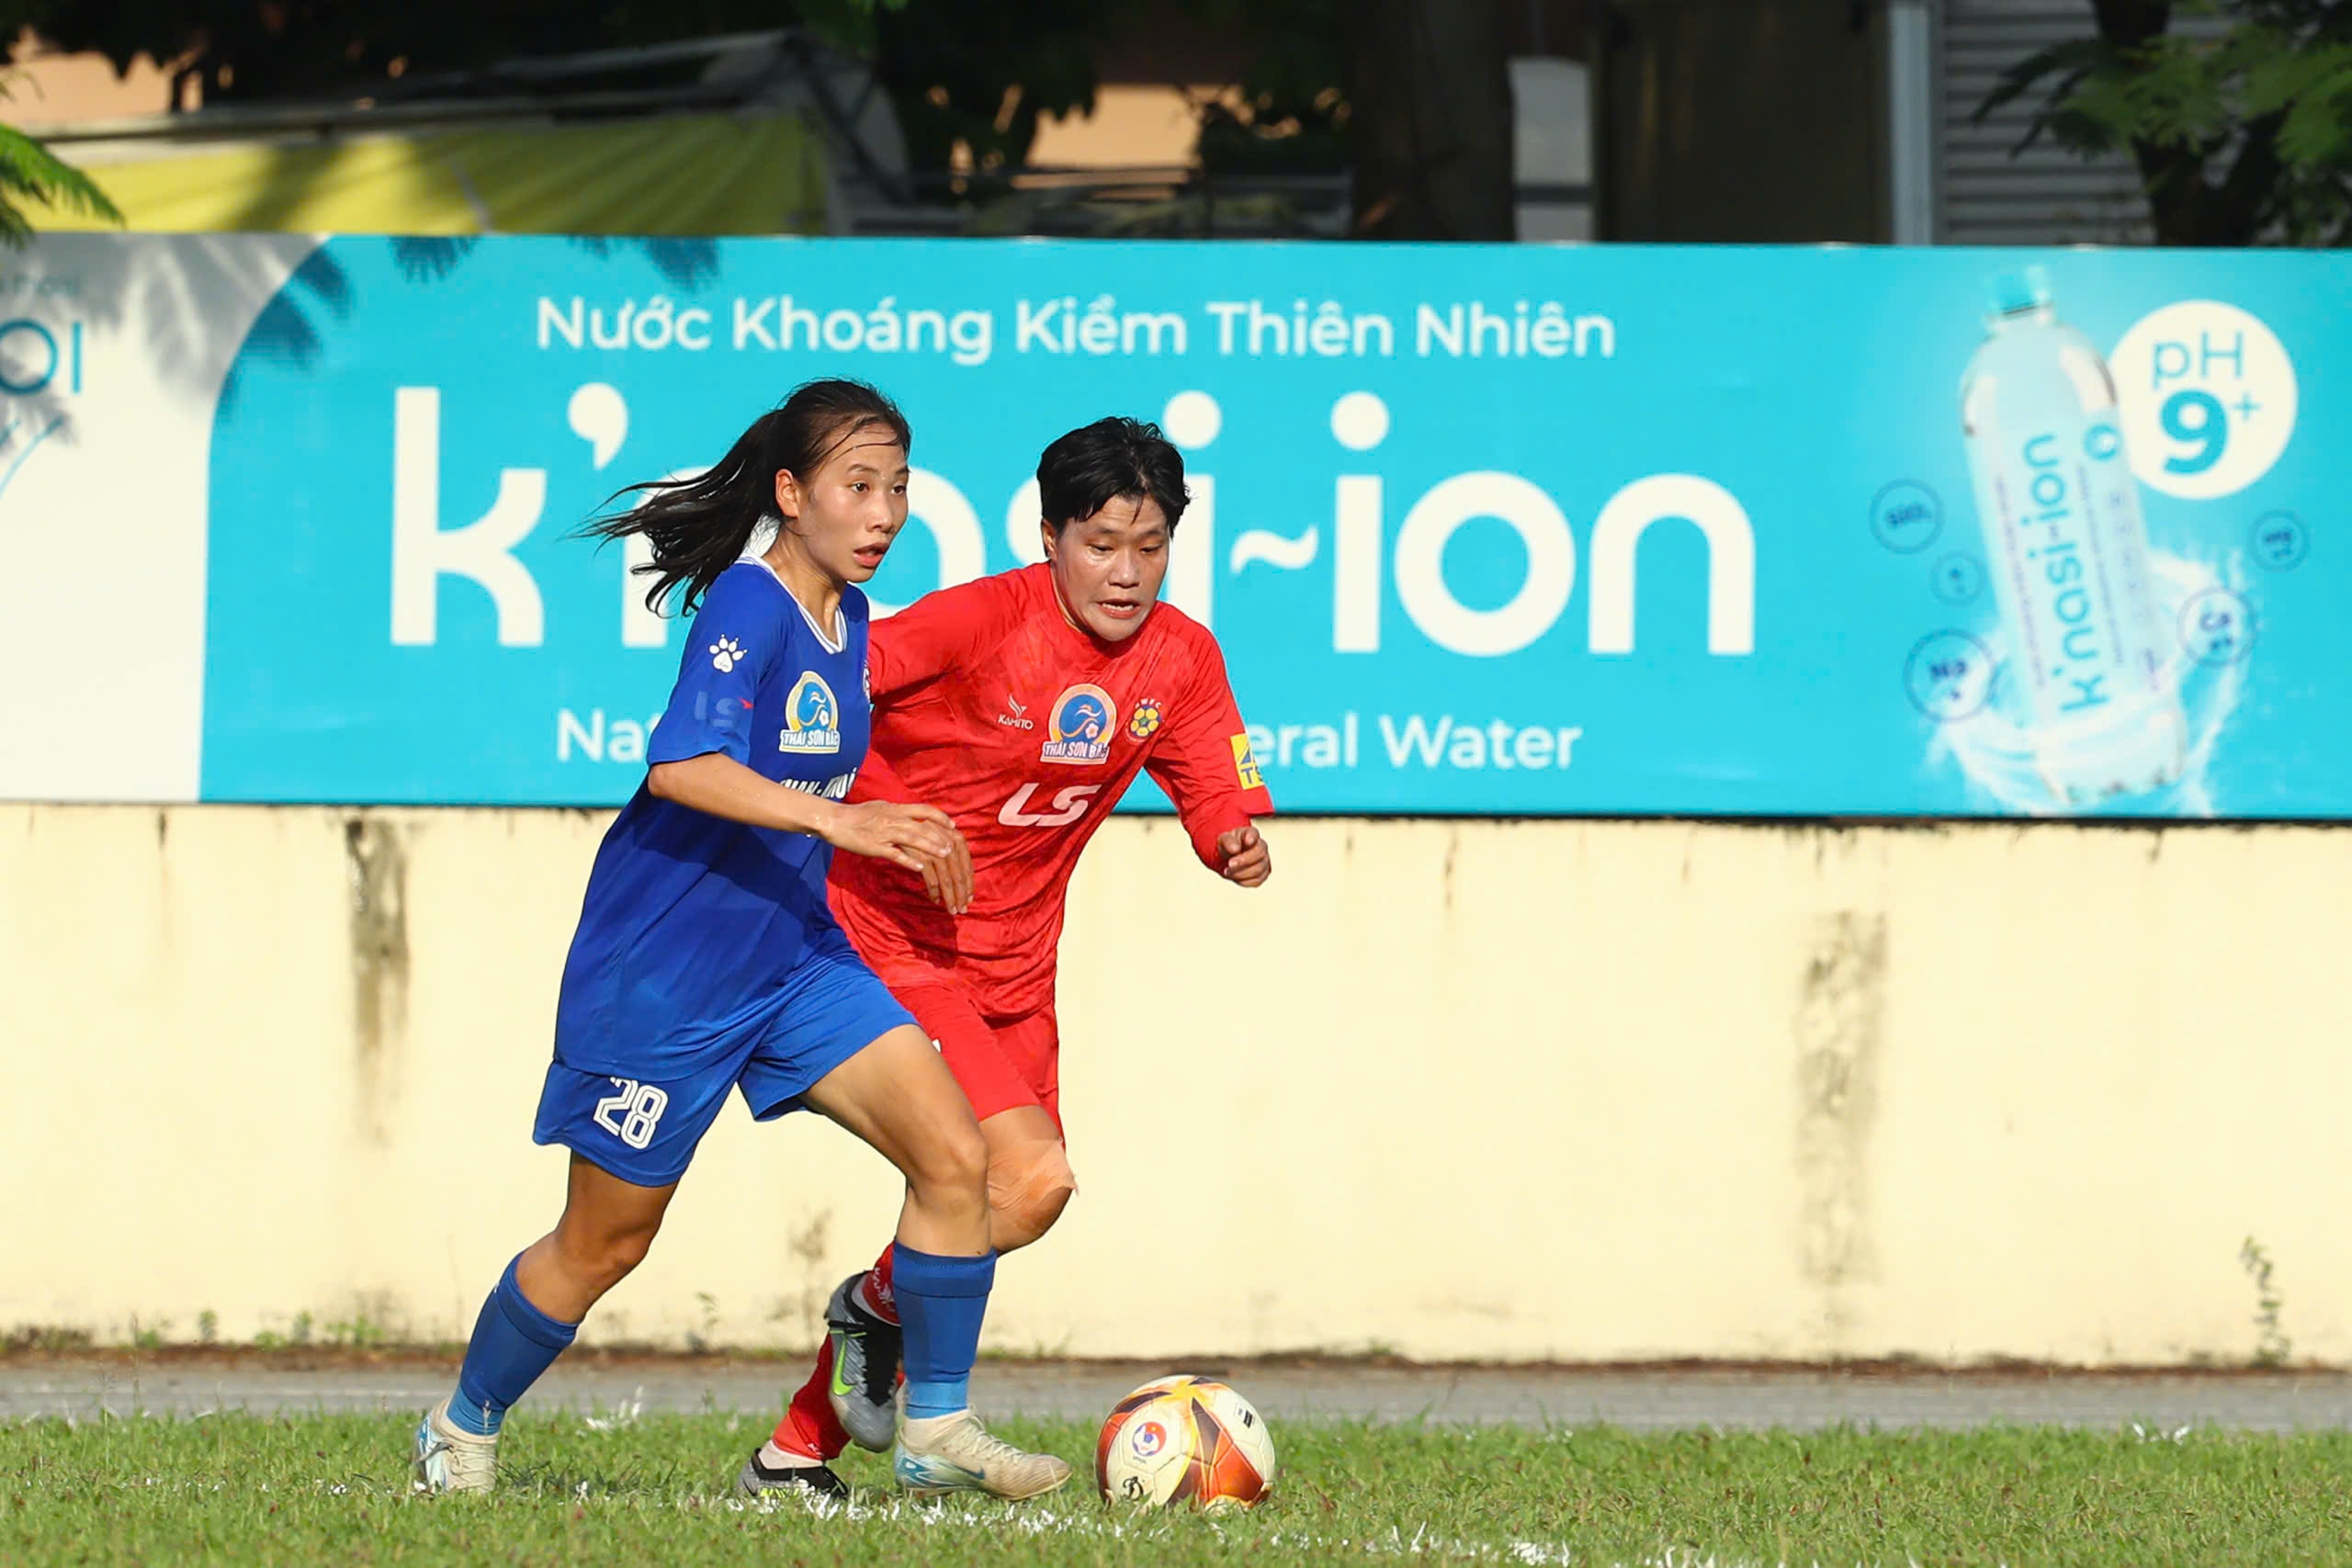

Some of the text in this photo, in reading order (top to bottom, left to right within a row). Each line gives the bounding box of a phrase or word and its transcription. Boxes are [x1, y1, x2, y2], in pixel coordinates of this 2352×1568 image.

[537, 294, 1615, 367] Nước Khoáng Kiềm Thiên Nhiên
[2152, 331, 2244, 389] pH
[1378, 715, 1583, 769] Water
[998, 782, 1102, 827] LS
[594, 1077, 669, 1150] 28
